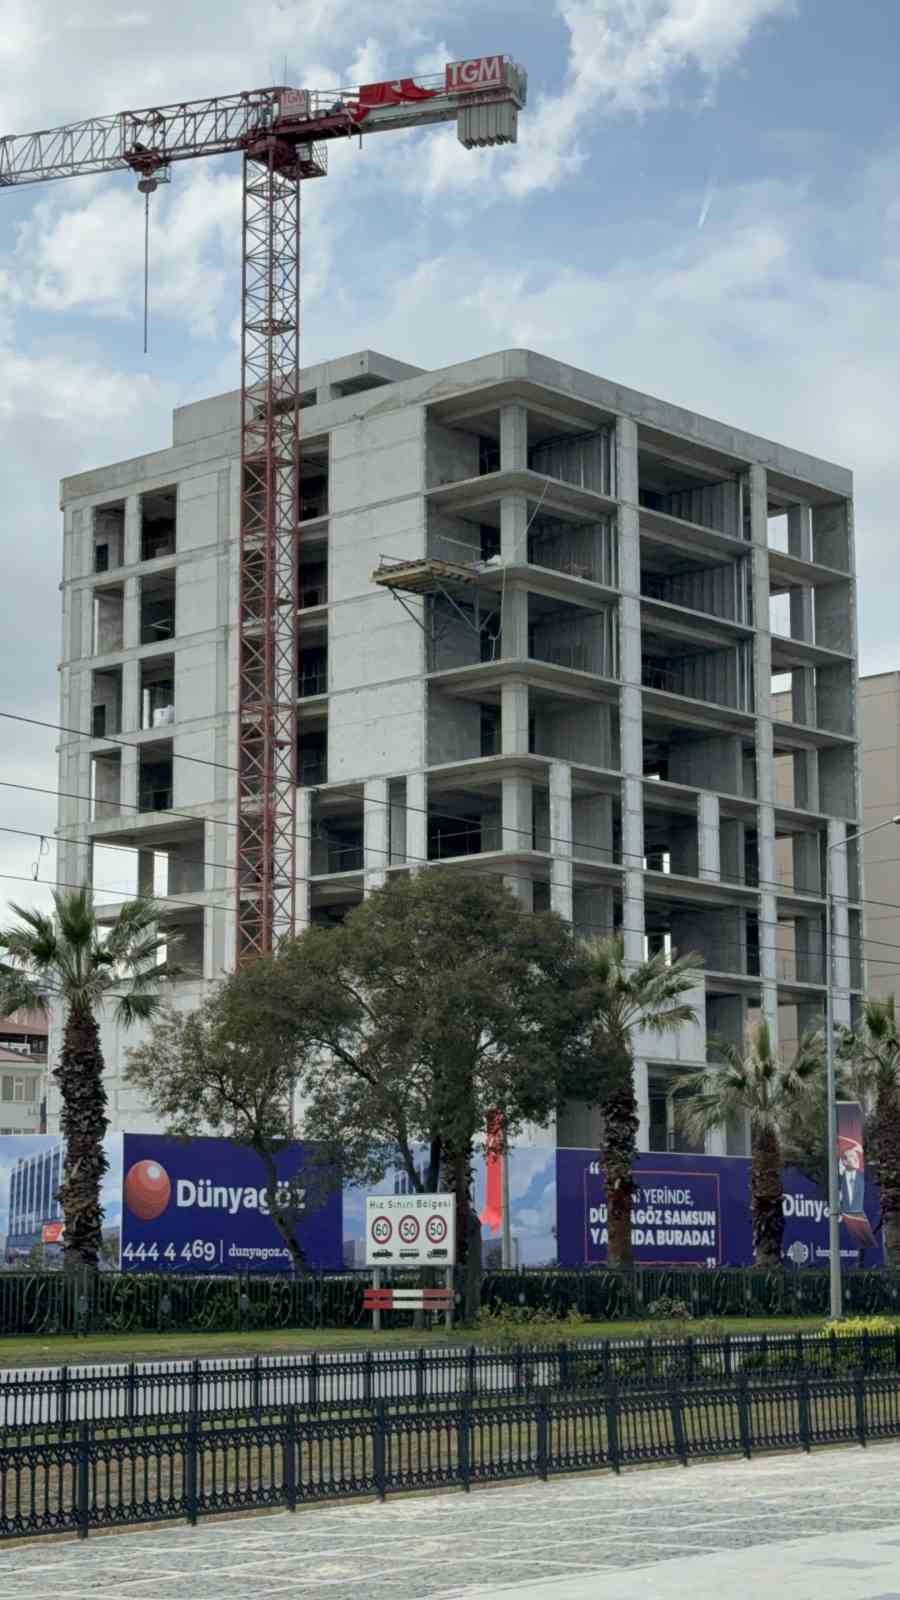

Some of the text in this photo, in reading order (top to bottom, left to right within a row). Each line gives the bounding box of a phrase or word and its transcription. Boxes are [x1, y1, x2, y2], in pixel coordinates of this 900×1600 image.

[448, 56, 501, 85] TGM
[177, 1178, 306, 1215] Dünyagöz
[643, 1185, 694, 1206] YERİNDE,
[589, 1203, 716, 1225] DÜAGÖZ SAMSUN
[781, 1193, 843, 1223] Dünya
[375, 1222, 443, 1236] 60 50 50
[590, 1228, 715, 1246] YADA BURADA!
[122, 1239, 215, 1262] 444 4 469
[228, 1243, 291, 1260] dunyagoz.c
